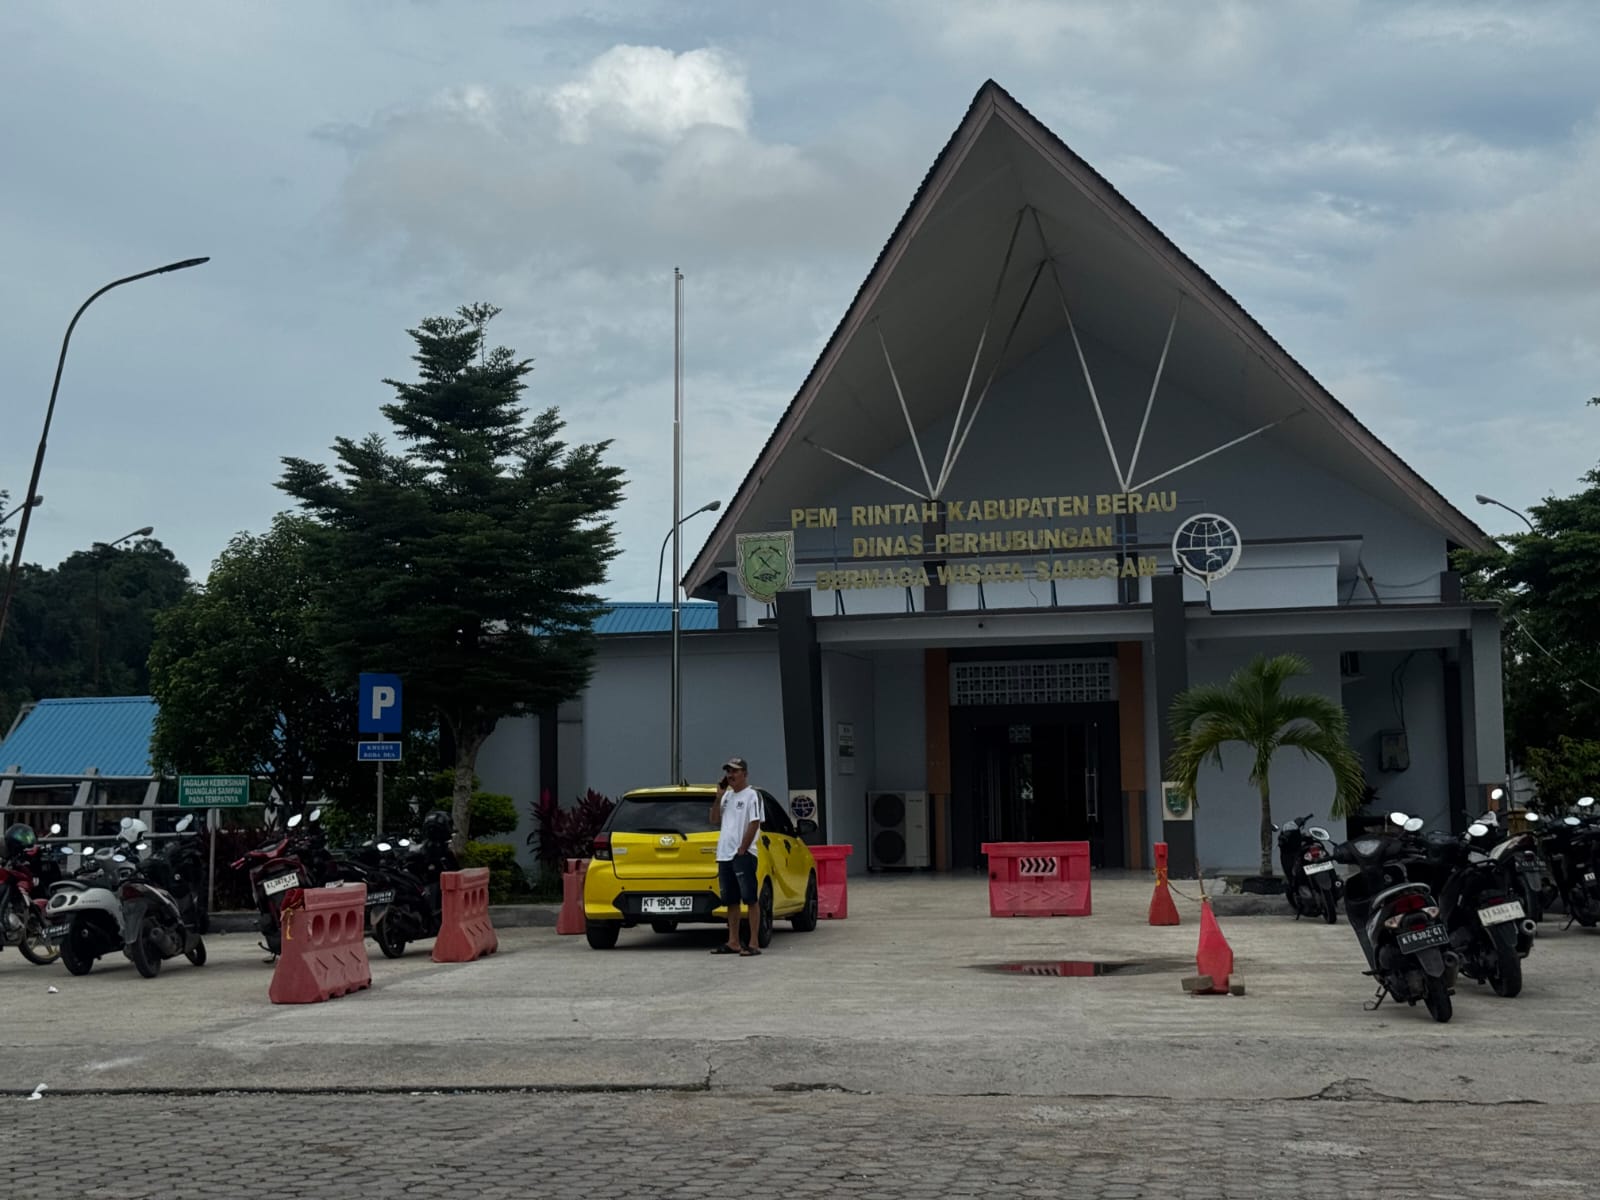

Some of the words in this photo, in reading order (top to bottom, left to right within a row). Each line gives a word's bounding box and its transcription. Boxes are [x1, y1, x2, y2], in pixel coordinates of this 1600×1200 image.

[852, 503, 938, 526] RINTAH
[947, 495, 1088, 521] KABUPATEN
[1096, 491, 1177, 515] BERAU
[853, 535, 924, 558] DINAS
[936, 526, 1112, 554] PERHUBUNGAN
[937, 562, 1024, 585] WISATA
[1034, 556, 1157, 582] SANGGAM
[372, 686, 395, 719] P
[188, 796, 204, 804] PADA
[205, 795, 239, 803] TEMPATNYA
[218, 787, 243, 795] SAMPAH
[644, 899, 654, 907] KT
[657, 898, 676, 906] 1904
